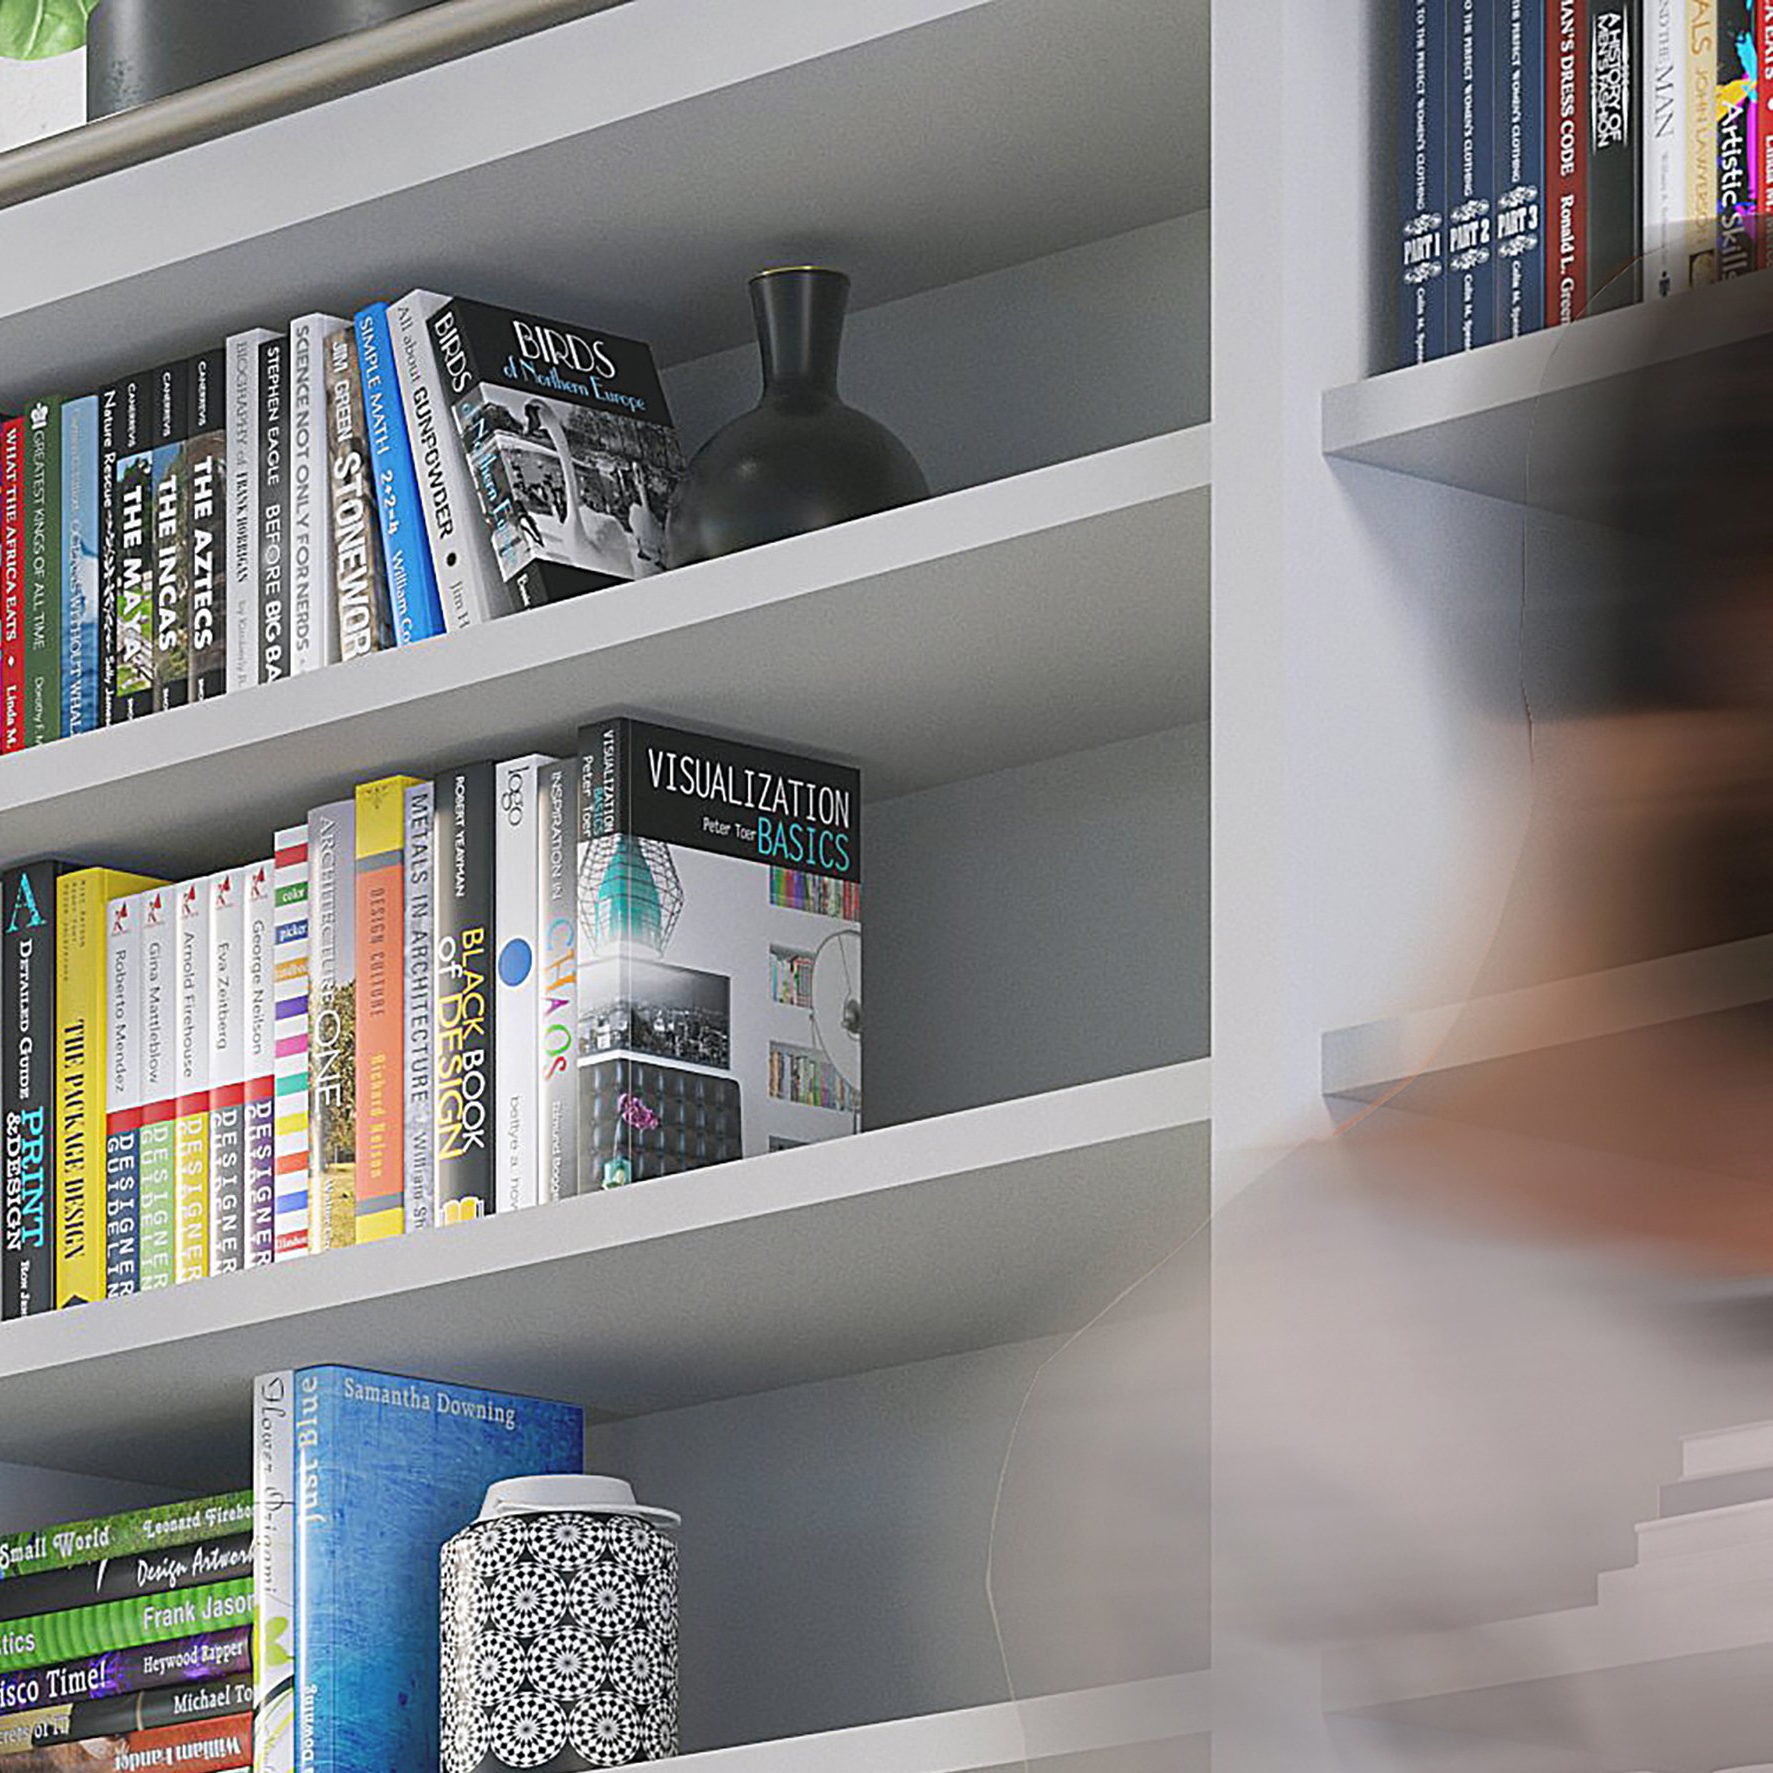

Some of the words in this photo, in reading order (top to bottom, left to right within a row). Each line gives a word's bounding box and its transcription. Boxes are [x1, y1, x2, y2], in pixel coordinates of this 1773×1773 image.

[1561, 55, 1575, 118] DRESS
[1561, 124, 1575, 176] CODE
[1560, 195, 1574, 252] Ronald
[297, 325, 309, 409] SCIENCE
[359, 316, 380, 385] SIMPLE
[434, 311, 473, 393] BIRDS
[512, 320, 616, 379] BIRDS
[503, 355, 519, 380] of
[520, 359, 590, 397] Northern
[589, 376, 646, 411] Europe
[5, 428, 17, 482] WHAT
[297, 412, 309, 458] NOT
[367, 392, 390, 455] MATH
[194, 456, 212, 521] THE
[411, 385, 454, 540] GUNPOWDER
[5, 486, 17, 523] THE
[123, 486, 141, 549] THE
[159, 475, 176, 539] THE
[297, 465, 309, 527] ONLY
[5, 525, 17, 594] AFRICA
[297, 534, 309, 572] FOR
[5, 597, 17, 642] EATS
[123, 558, 141, 662] MAYA
[159, 548, 177, 652] INCAS
[194, 529, 212, 650] AZTECS
[297, 574, 309, 650] NERDS
[502, 766, 528, 828] logo
[604, 729, 616, 836] VISUALIZATION
[648, 749, 850, 829] VISUALIZATION
[411, 793, 428, 884] METALS
[550, 771, 562, 876] INSPIRATION
[703, 817, 731, 836] Peter
[734, 822, 756, 841] Toer
[758, 816, 850, 872] BASICS
[317, 818, 336, 1000] ARCHITECTURE
[369, 888, 386, 945] DESIGN
[411, 894, 427, 920] IN
[550, 881, 562, 899] IN
[114, 950, 128, 1019] Roberto
[147, 942, 161, 982] Gina
[183, 931, 196, 989] Arnold
[217, 942, 230, 971] Eva
[250, 920, 266, 985] George
[369, 951, 386, 1017] CULTURE
[437, 936, 460, 977] of
[461, 926, 484, 1035] BLACK
[18, 939, 32, 1032] DETAILED
[214, 975, 231, 1051] Zeitberg
[411, 930, 428, 1102] ARCHITECTURE
[543, 918, 576, 1080] CHAOS
[63, 1019, 85, 1069] THE
[148, 987, 162, 1083] Mattleblow
[183, 994, 196, 1078] Firehouse
[252, 991, 266, 1054] Neilson
[18, 1037, 32, 1100] GUIDE
[114, 1024, 128, 1094] Mendez
[315, 1010, 340, 1106] ONE
[438, 993, 461, 1160] DESIGN
[63, 1073, 85, 1174] PACKAGE
[461, 1048, 484, 1153] BOOK
[6, 1112, 21, 1250] &DESIGN
[21, 1107, 43, 1248] PRINT
[222, 1110, 238, 1272] DESIGNER
[63, 1181, 85, 1260] DESIGN
[119, 1134, 134, 1293] DESIGNER
[297, 1377, 318, 1447] Blue
[344, 1378, 431, 1411] Samantha
[436, 1390, 517, 1429] Downing
[297, 1451, 318, 1522] Just
[53, 1526, 110, 1558] World
[142, 1511, 202, 1540] Leonard
[135, 1553, 189, 1589] Design
[143, 1604, 195, 1630] Frank
[45, 1662, 107, 1697] Time!
[173, 1689, 225, 1714] Michael
